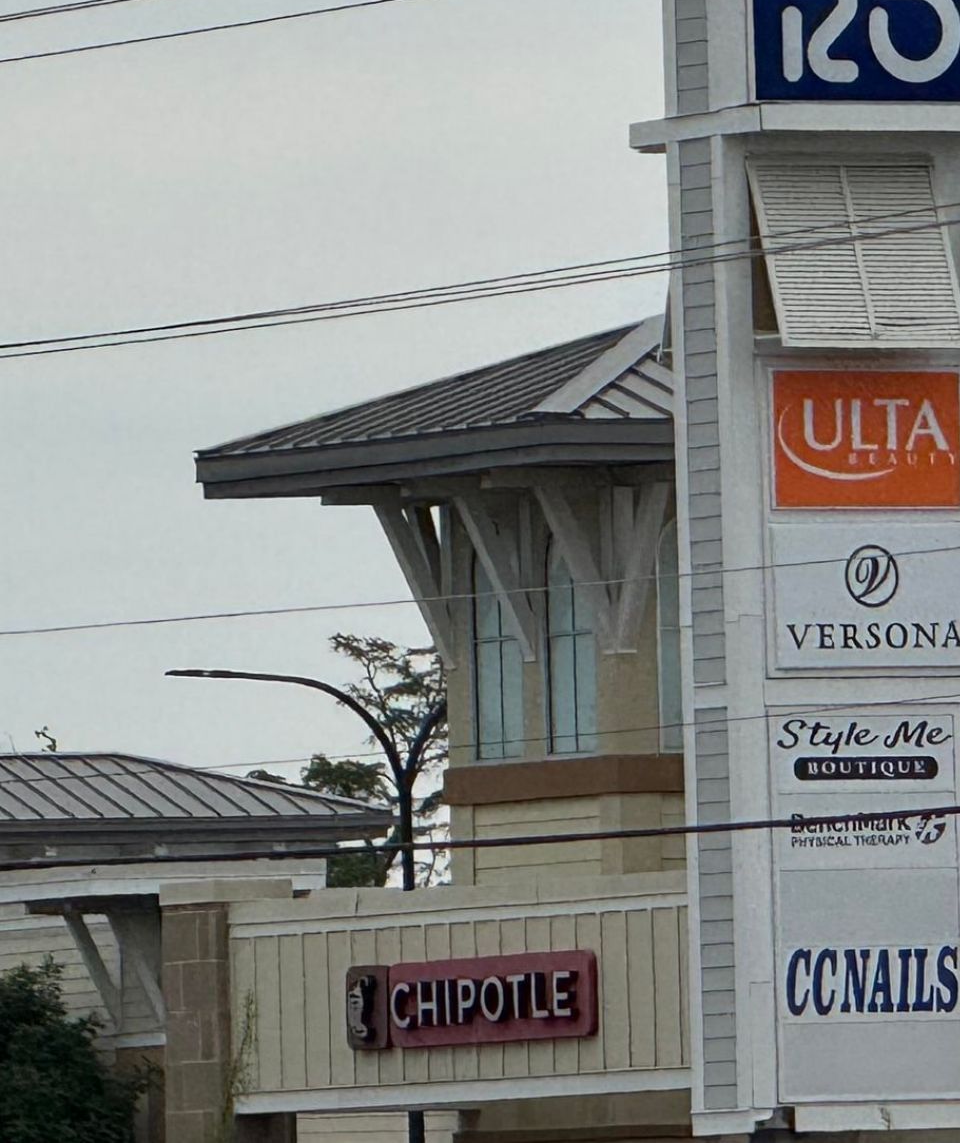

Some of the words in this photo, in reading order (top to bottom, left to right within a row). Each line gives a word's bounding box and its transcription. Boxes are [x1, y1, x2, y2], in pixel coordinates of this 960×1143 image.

[804, 399, 949, 450] ULTA
[848, 452, 956, 466] BEAUTY
[777, 719, 879, 754] Style
[884, 720, 952, 748] Me
[807, 761, 927, 777] BOUTIQUE
[791, 836, 852, 848] PHYSICAL
[854, 834, 910, 846] THERAPY
[390, 970, 573, 1029] CHIPOTLE
